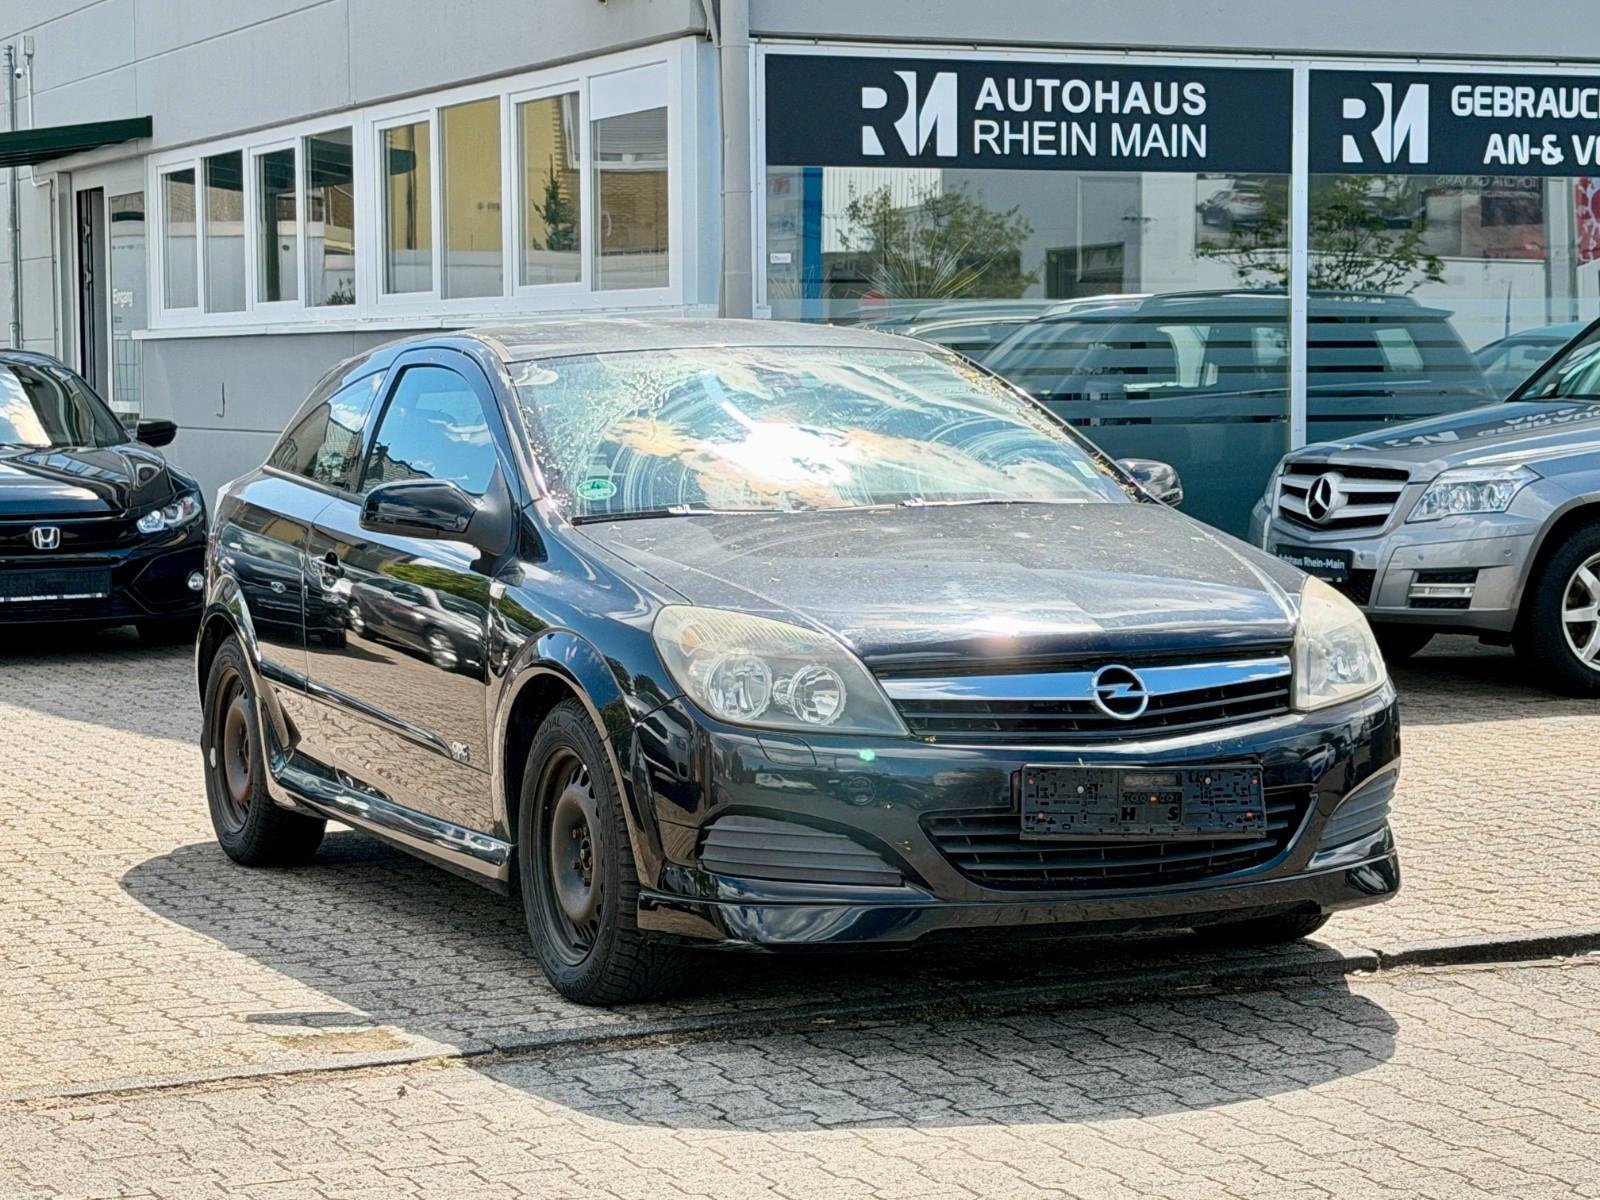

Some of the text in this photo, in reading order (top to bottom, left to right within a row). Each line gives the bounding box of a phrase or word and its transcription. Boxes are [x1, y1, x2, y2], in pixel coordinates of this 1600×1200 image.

[861, 70, 958, 157] RM
[974, 77, 1207, 116] AUTOHAUS
[1451, 85, 1600, 119] GEBRAUC
[973, 120, 1208, 158] RHEIN MAIN
[1342, 82, 1430, 164] RM
[1303, 556, 1345, 569] Rhein-Main
